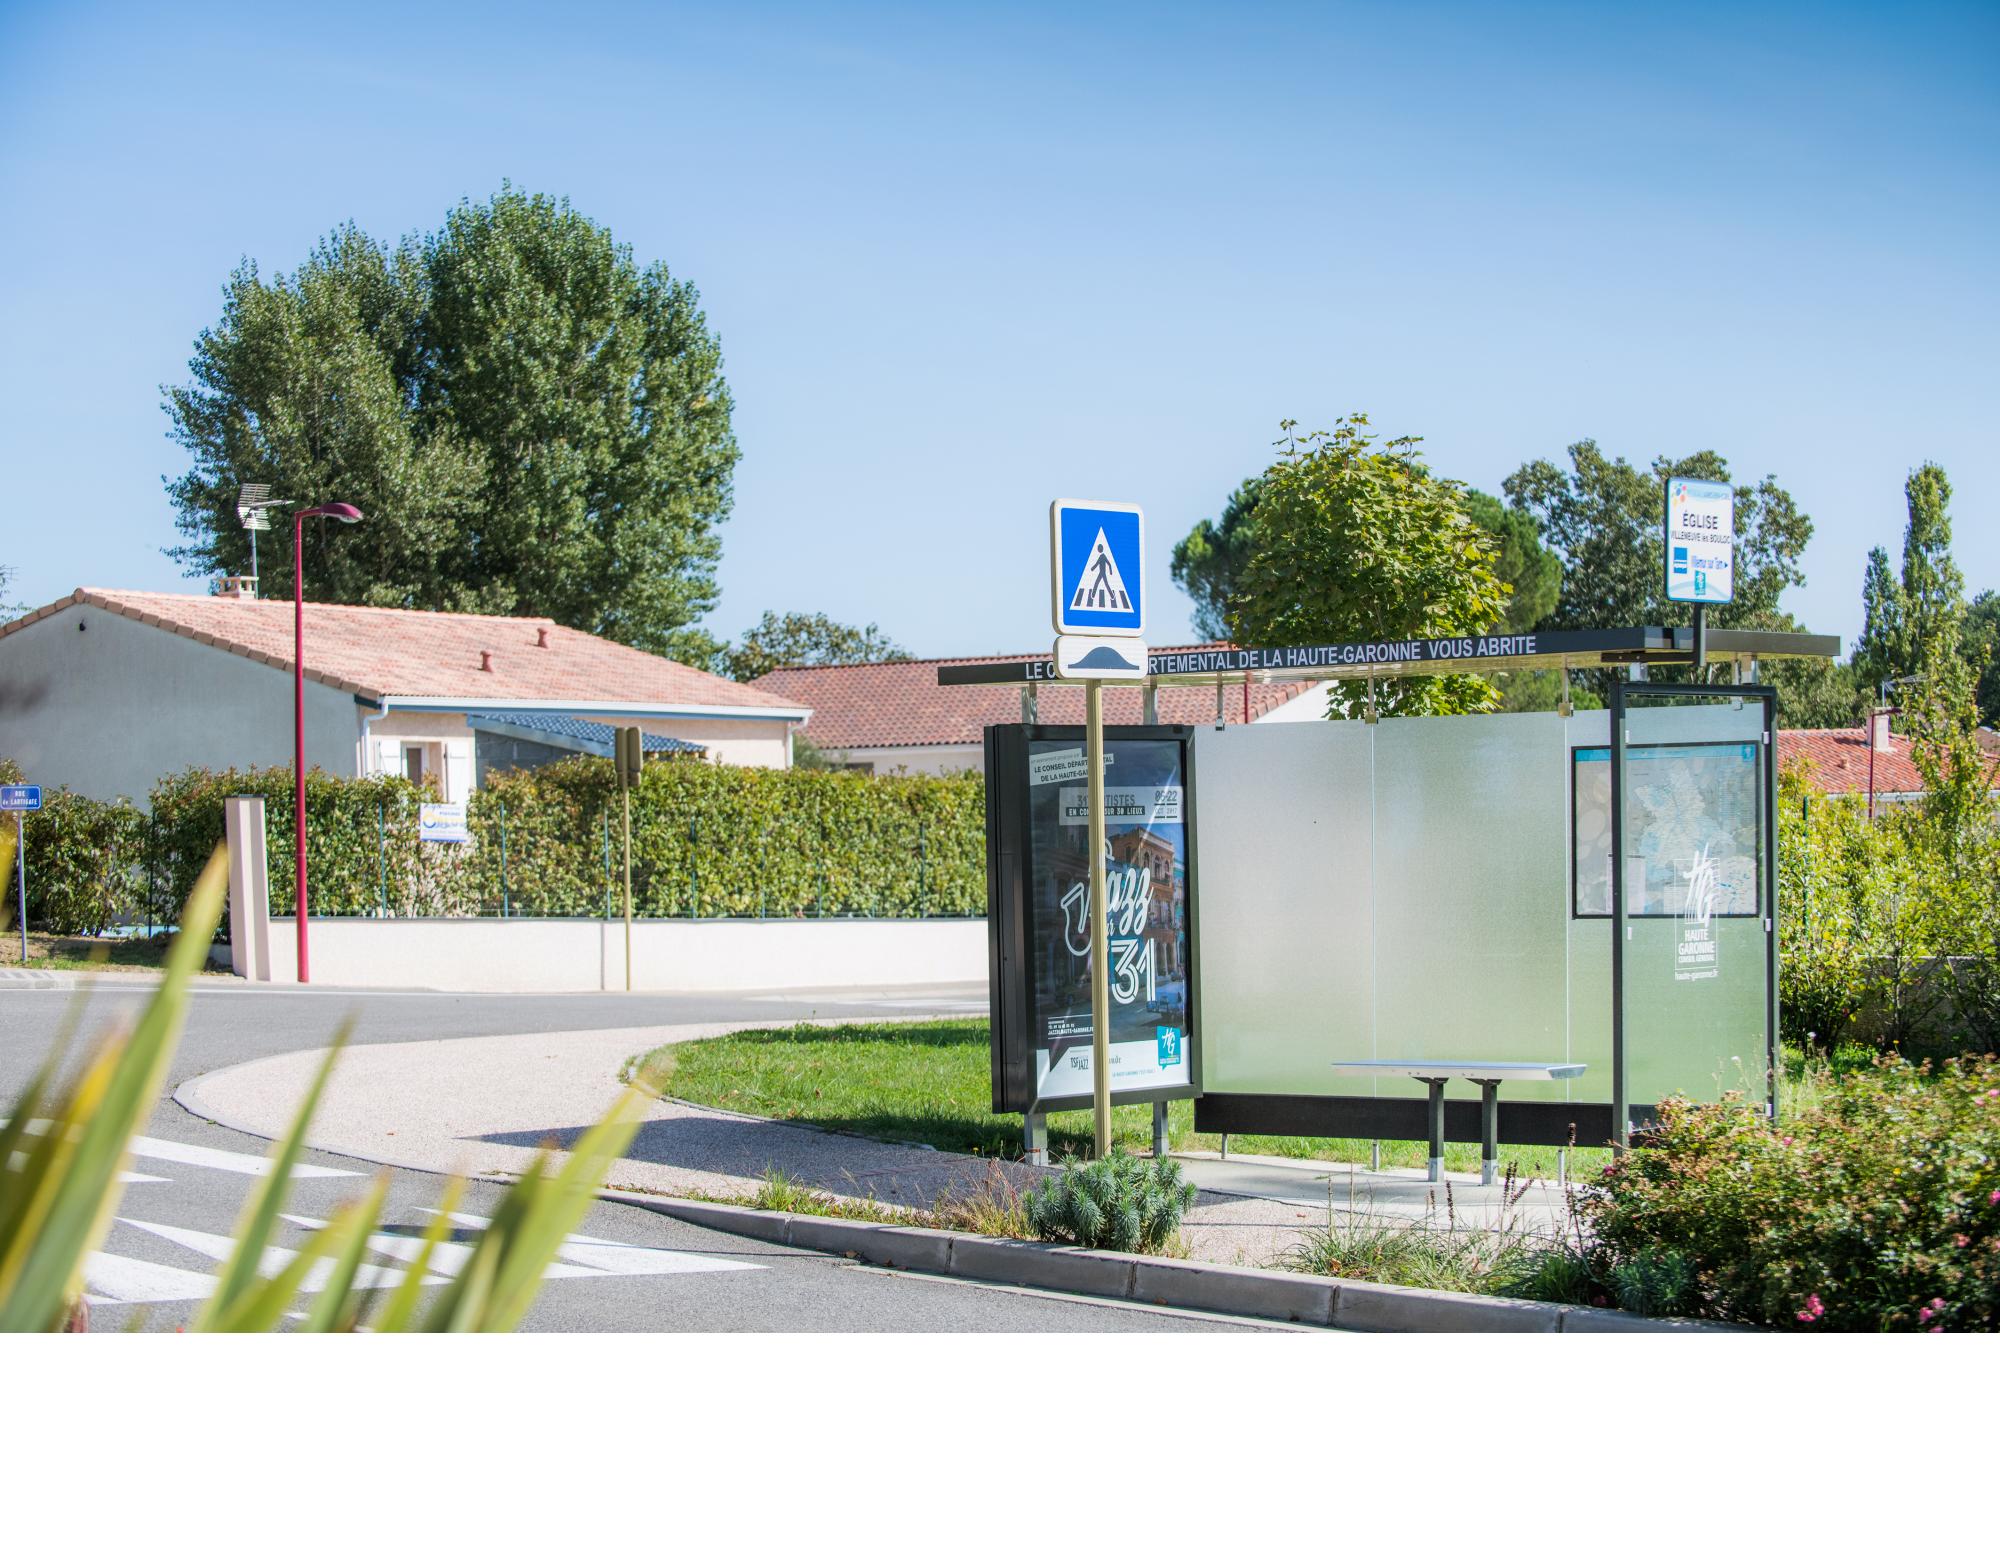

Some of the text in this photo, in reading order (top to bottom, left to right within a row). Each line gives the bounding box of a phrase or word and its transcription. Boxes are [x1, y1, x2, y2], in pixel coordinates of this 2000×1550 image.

[1682, 509, 1718, 530] ÉGLISE
[1025, 663, 1043, 680] LE
[1149, 653, 1235, 674] RTEMENTAL
[1239, 650, 1259, 669] DE
[1263, 649, 1283, 667] LA
[1287, 641, 1421, 666] HAUTE-GARONNE
[1428, 639, 1473, 659] VOUS
[1476, 635, 1537, 656] ABRITE
[1104, 795, 1136, 806] TISTES
[1684, 928, 1709, 942] HAUTE
[1678, 941, 1716, 956] GARONNE
[1111, 938, 1155, 1005] 31
